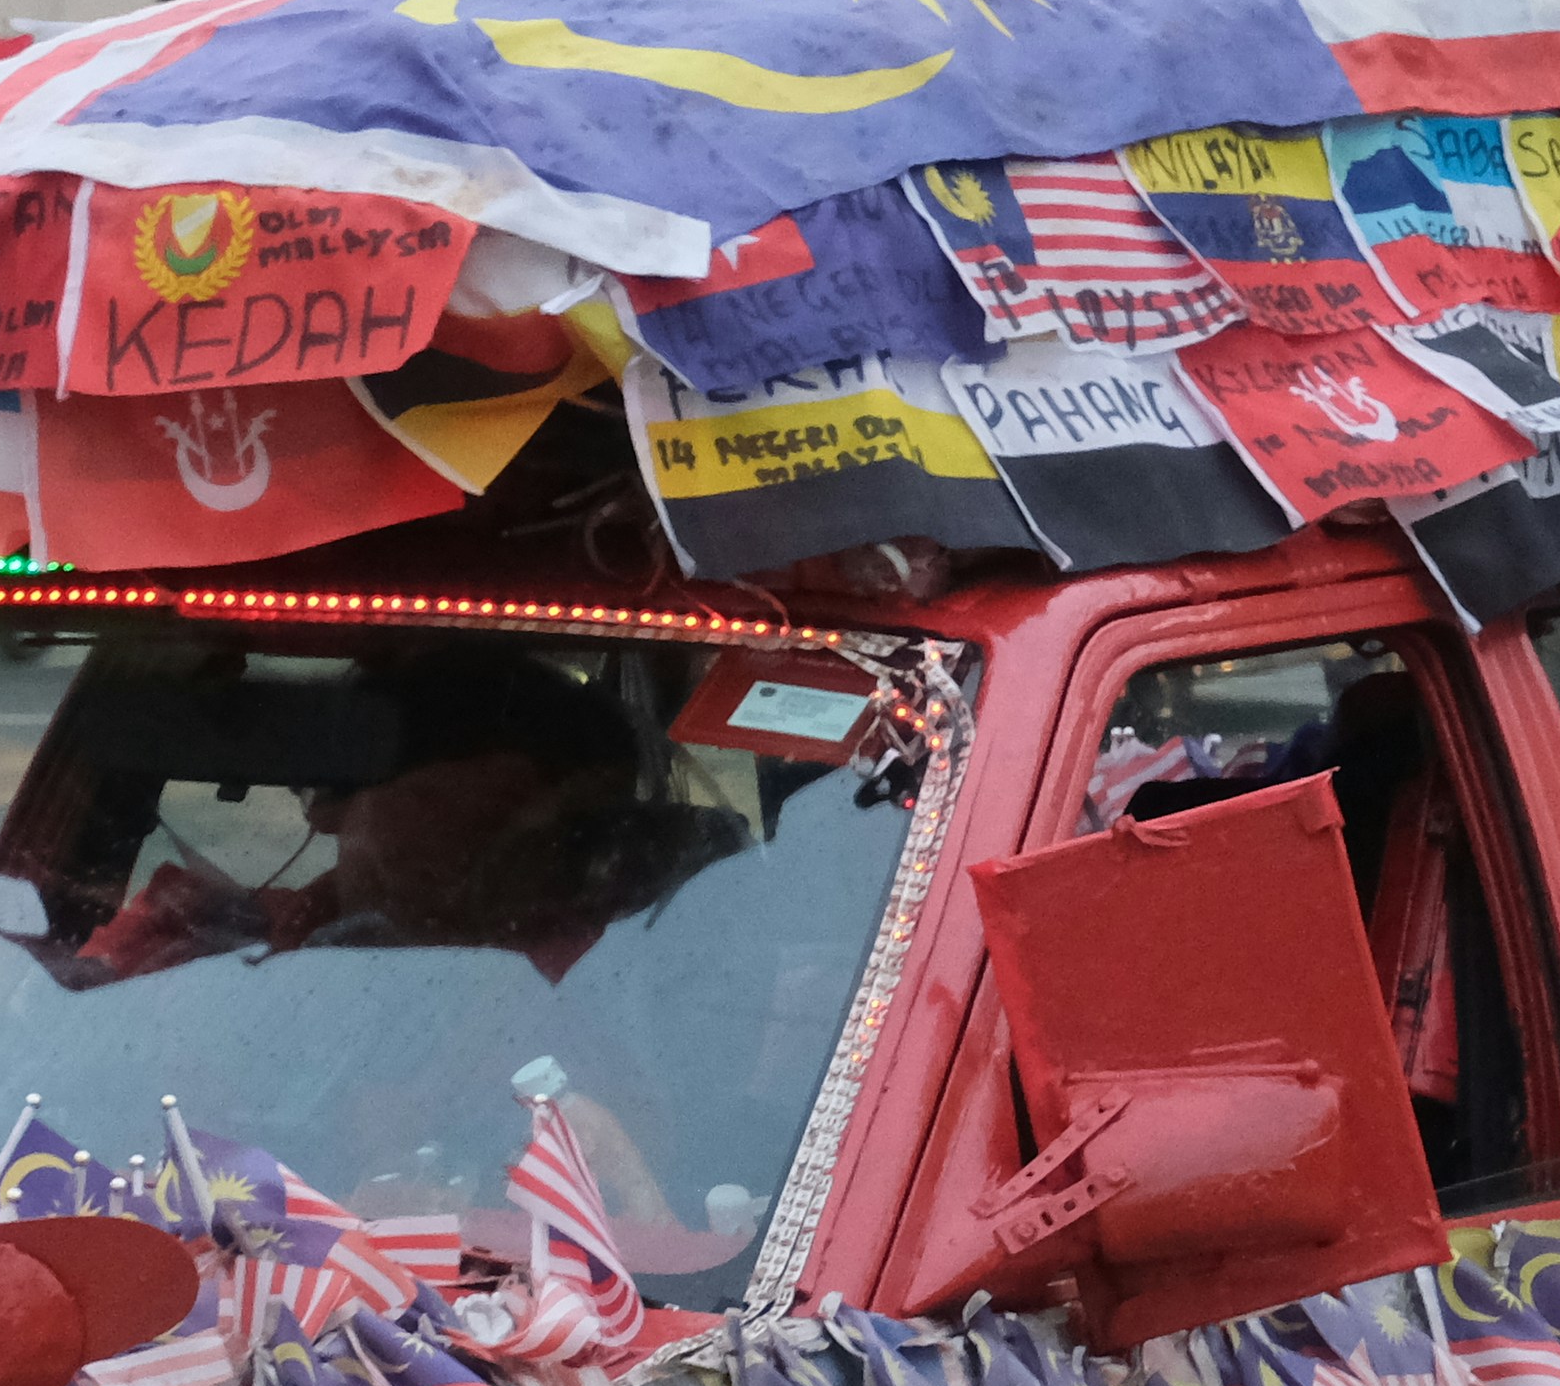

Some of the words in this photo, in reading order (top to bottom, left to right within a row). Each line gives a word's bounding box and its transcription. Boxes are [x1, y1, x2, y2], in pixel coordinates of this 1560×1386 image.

[1396, 115, 1507, 179] SABA
[105, 284, 416, 391] KEDAH
[965, 377, 1197, 451] PAHANG
